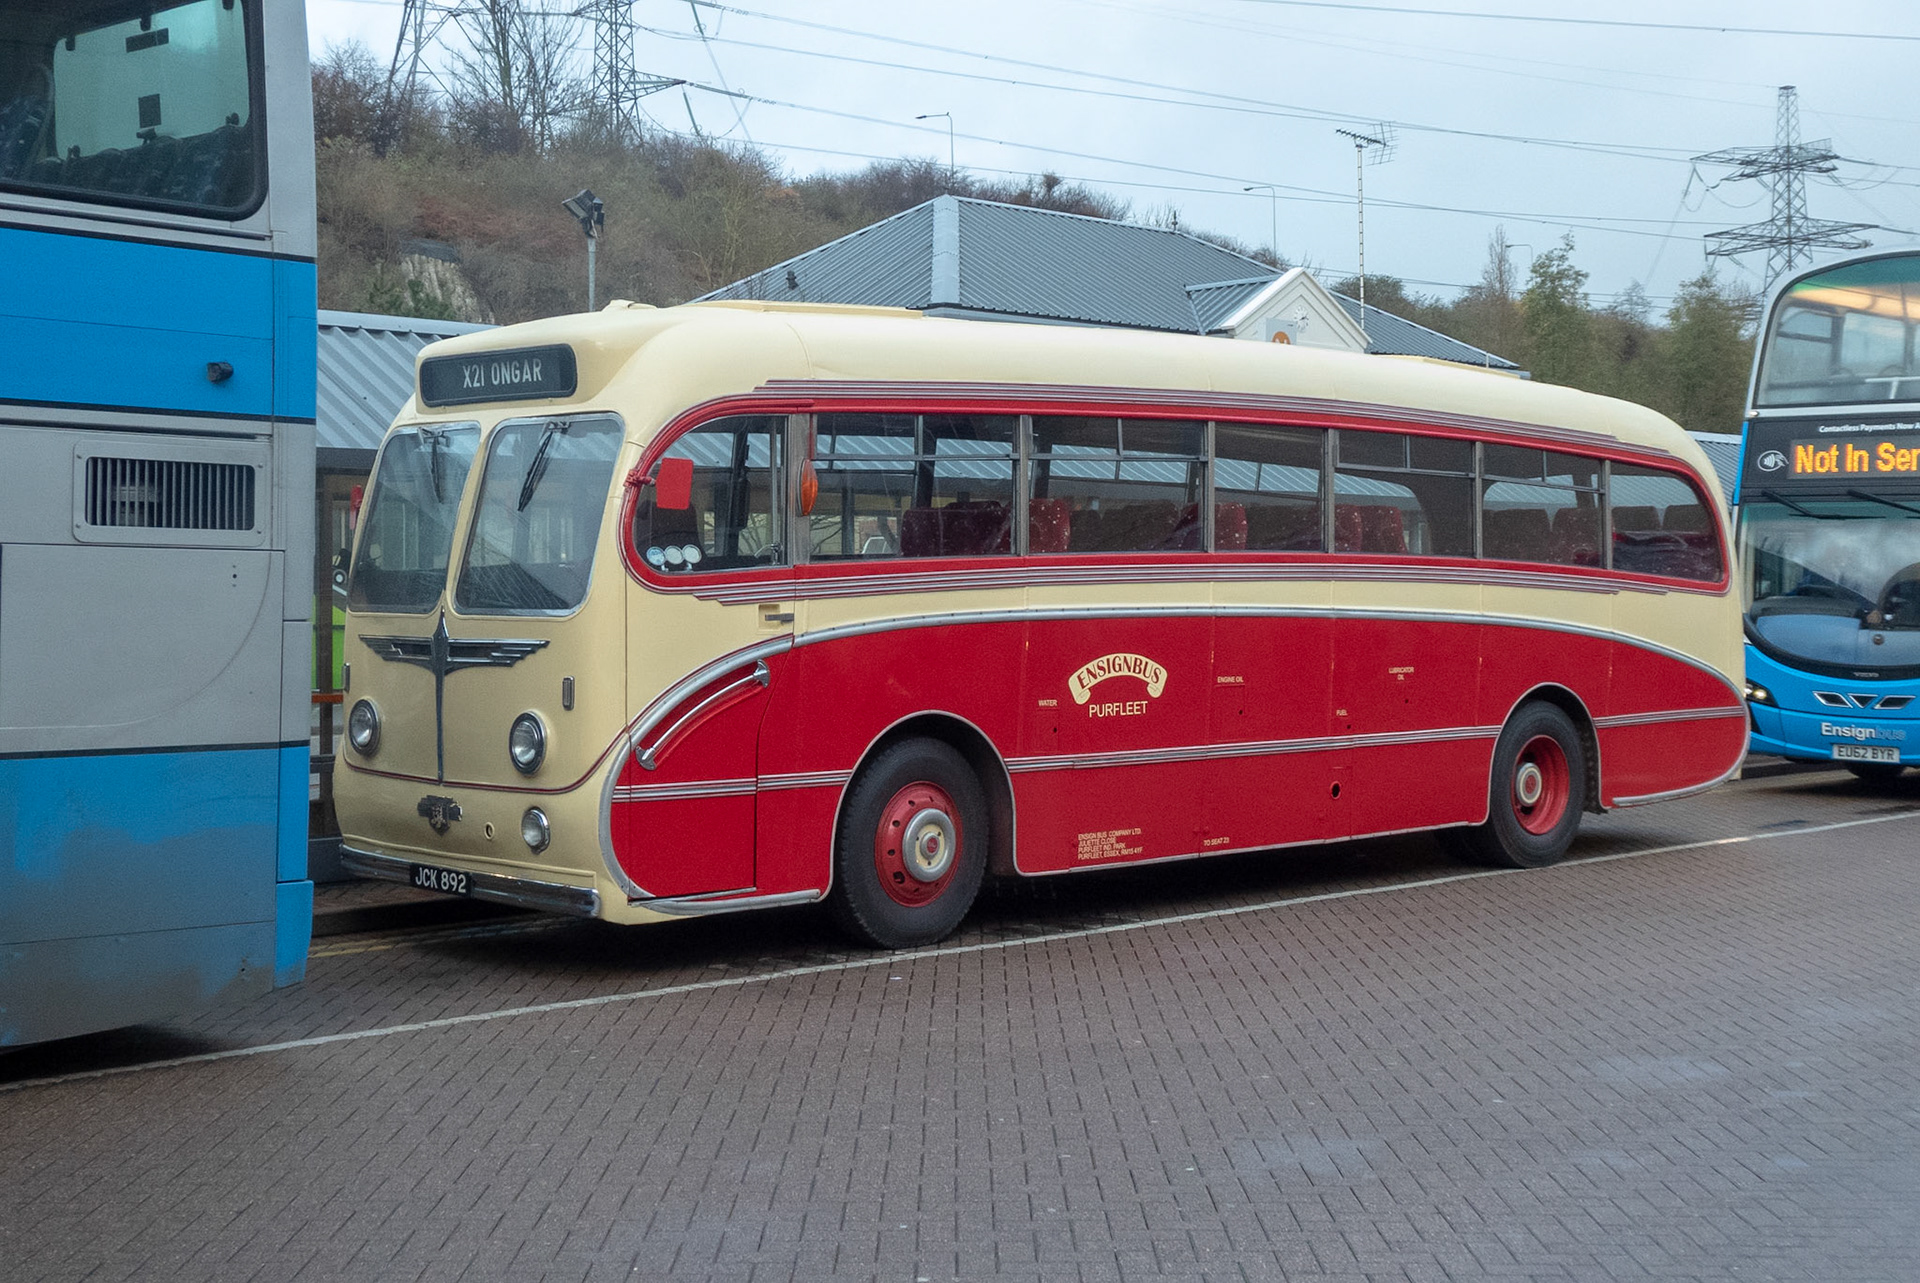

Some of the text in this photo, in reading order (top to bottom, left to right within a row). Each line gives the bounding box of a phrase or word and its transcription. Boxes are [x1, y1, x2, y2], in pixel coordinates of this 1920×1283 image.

[463, 359, 542, 388] X21 ONGAR
[1819, 424, 1859, 432] Contactless
[1860, 423, 1896, 432] Payments
[1795, 442, 1920, 473] Not In Ser
[1076, 655, 1162, 689] ENSIGNBUS
[1089, 701, 1148, 718] PURFLEET
[1821, 722, 1906, 741] Ensignbus
[1838, 746, 1894, 760] EU62 BYR
[1109, 829, 1131, 837] COMPANY
[415, 867, 467, 893] JCK 892
